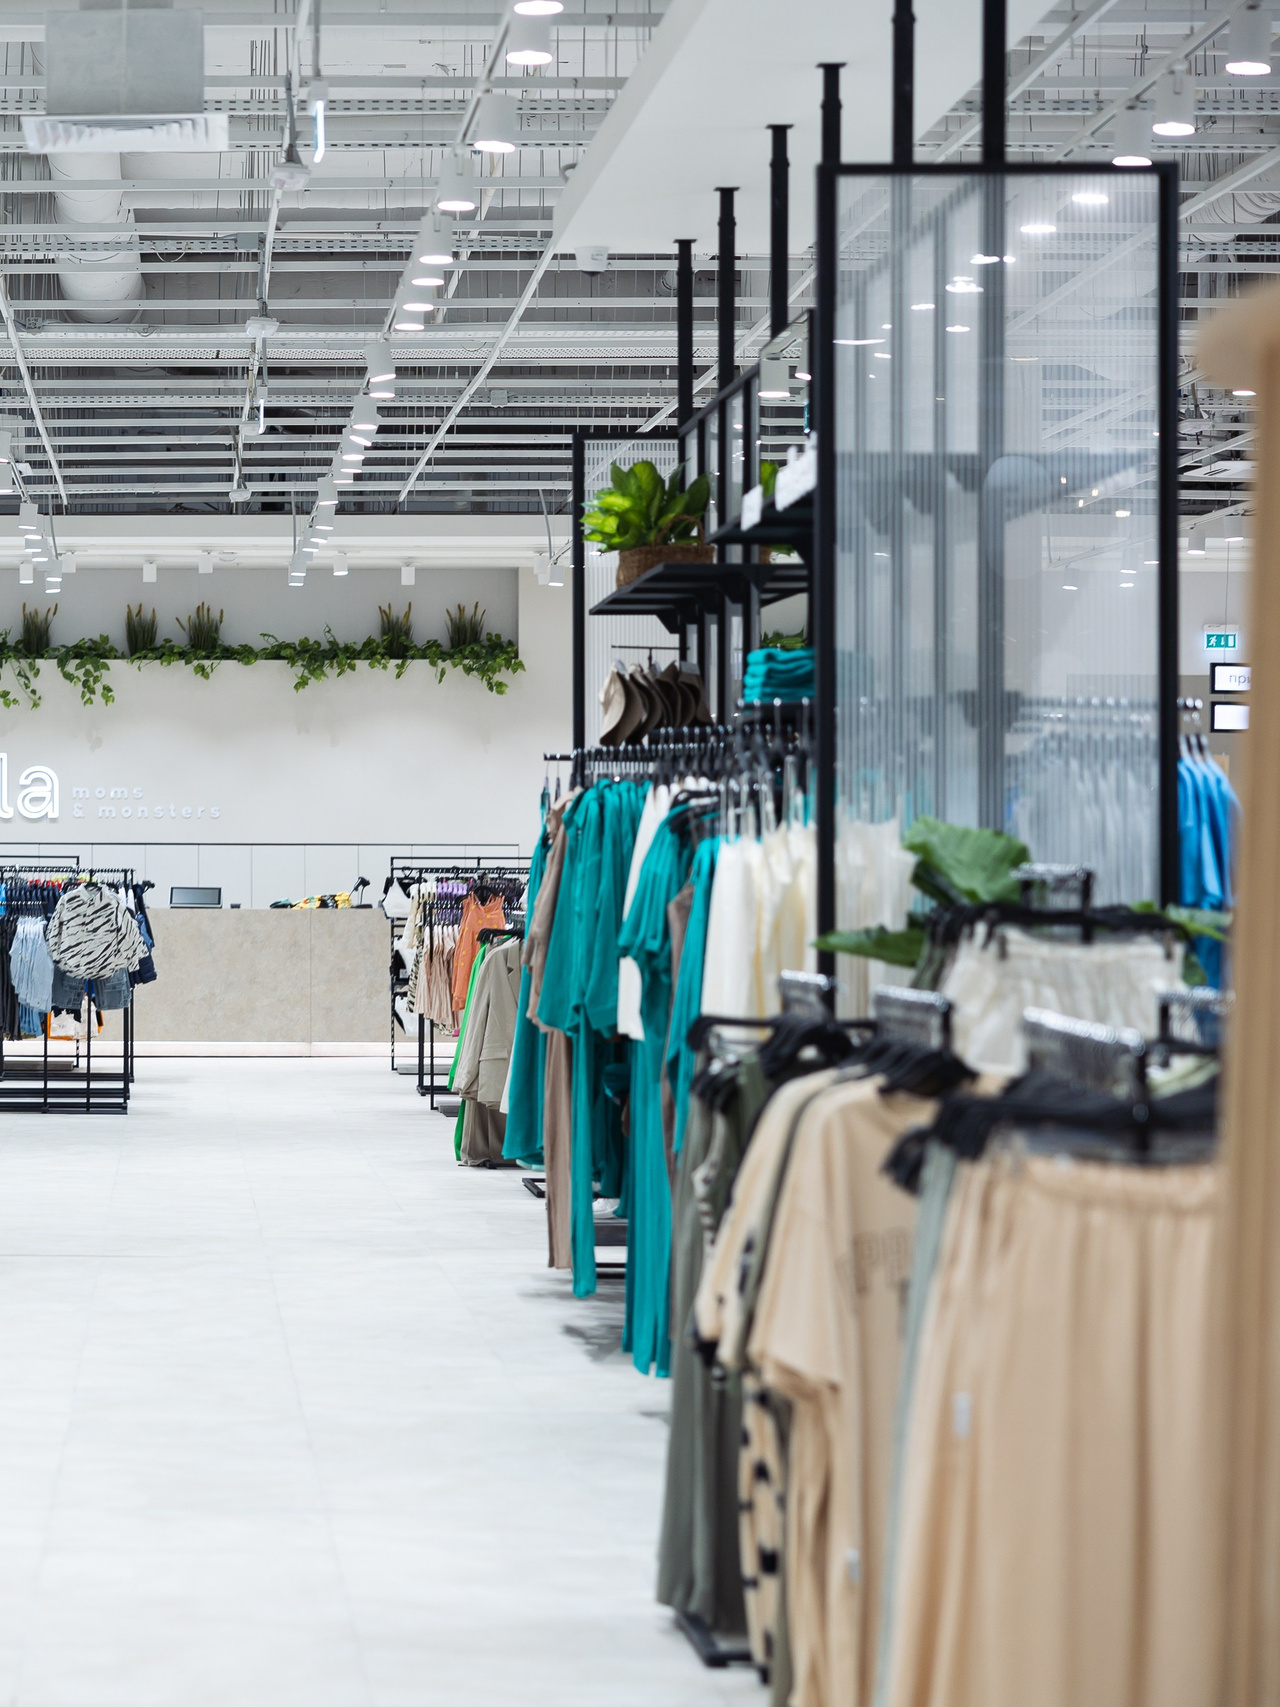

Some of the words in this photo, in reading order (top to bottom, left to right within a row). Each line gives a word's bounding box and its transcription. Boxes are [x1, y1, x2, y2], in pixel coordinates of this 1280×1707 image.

[71, 785, 145, 800] moms
[71, 802, 85, 819] &
[98, 802, 222, 819] monsters
